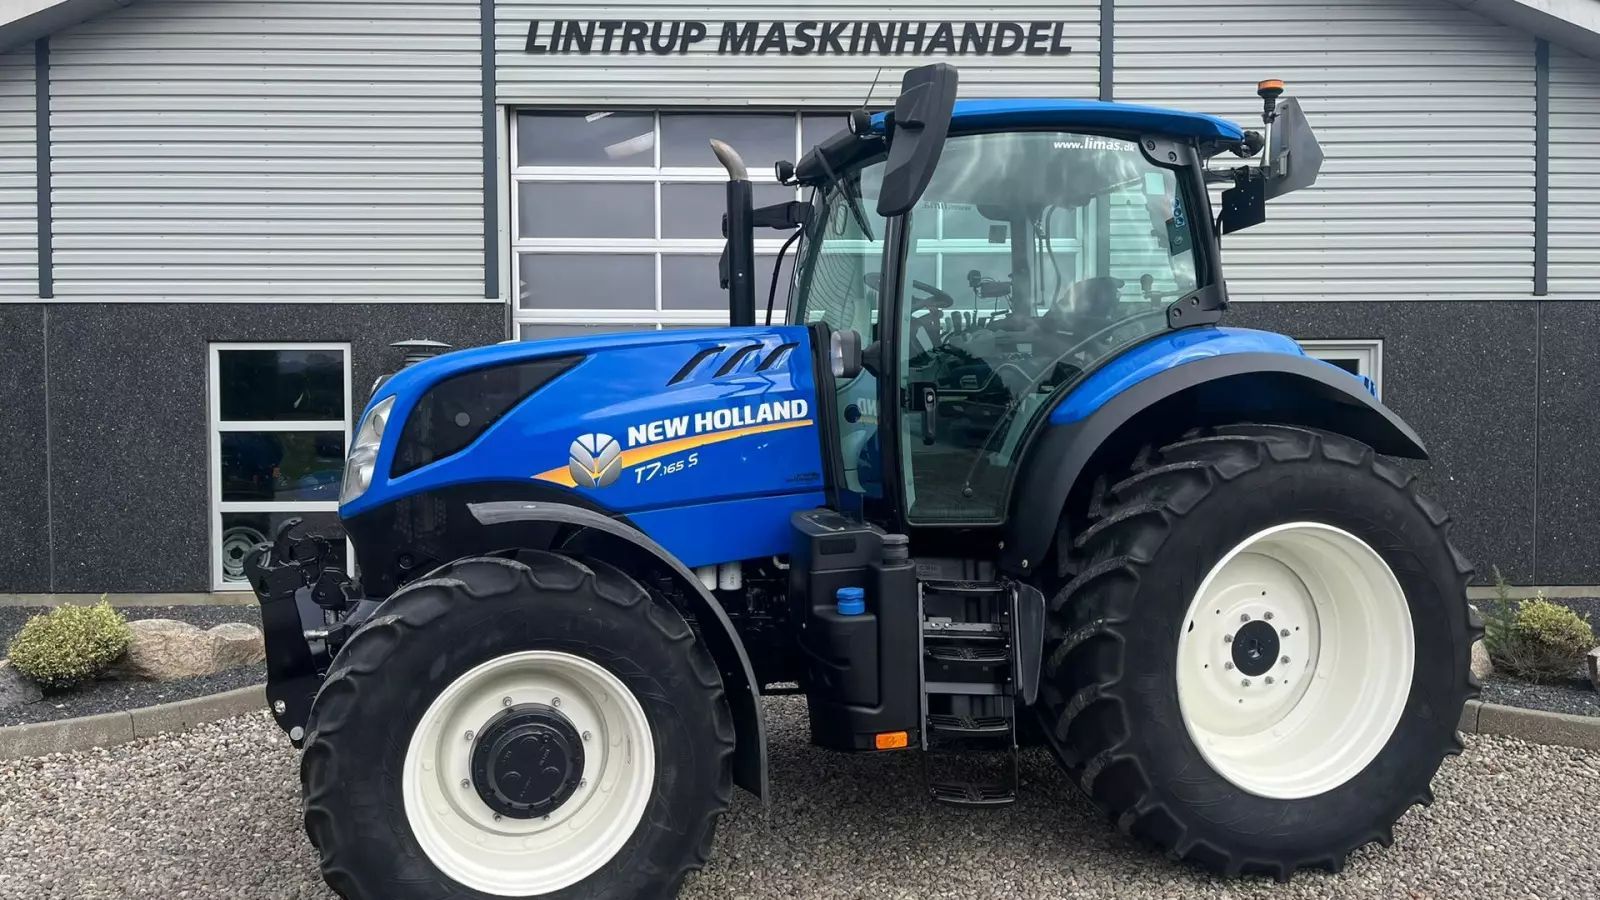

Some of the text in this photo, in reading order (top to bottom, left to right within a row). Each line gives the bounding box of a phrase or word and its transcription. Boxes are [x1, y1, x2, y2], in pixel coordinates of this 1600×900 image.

[525, 21, 1072, 55] LINTRUP MASKINHANDEL
[1053, 137, 1136, 152] www.limas.dk
[628, 399, 809, 447] NEW HOLLAND
[634, 452, 699, 484] T7.165 S
